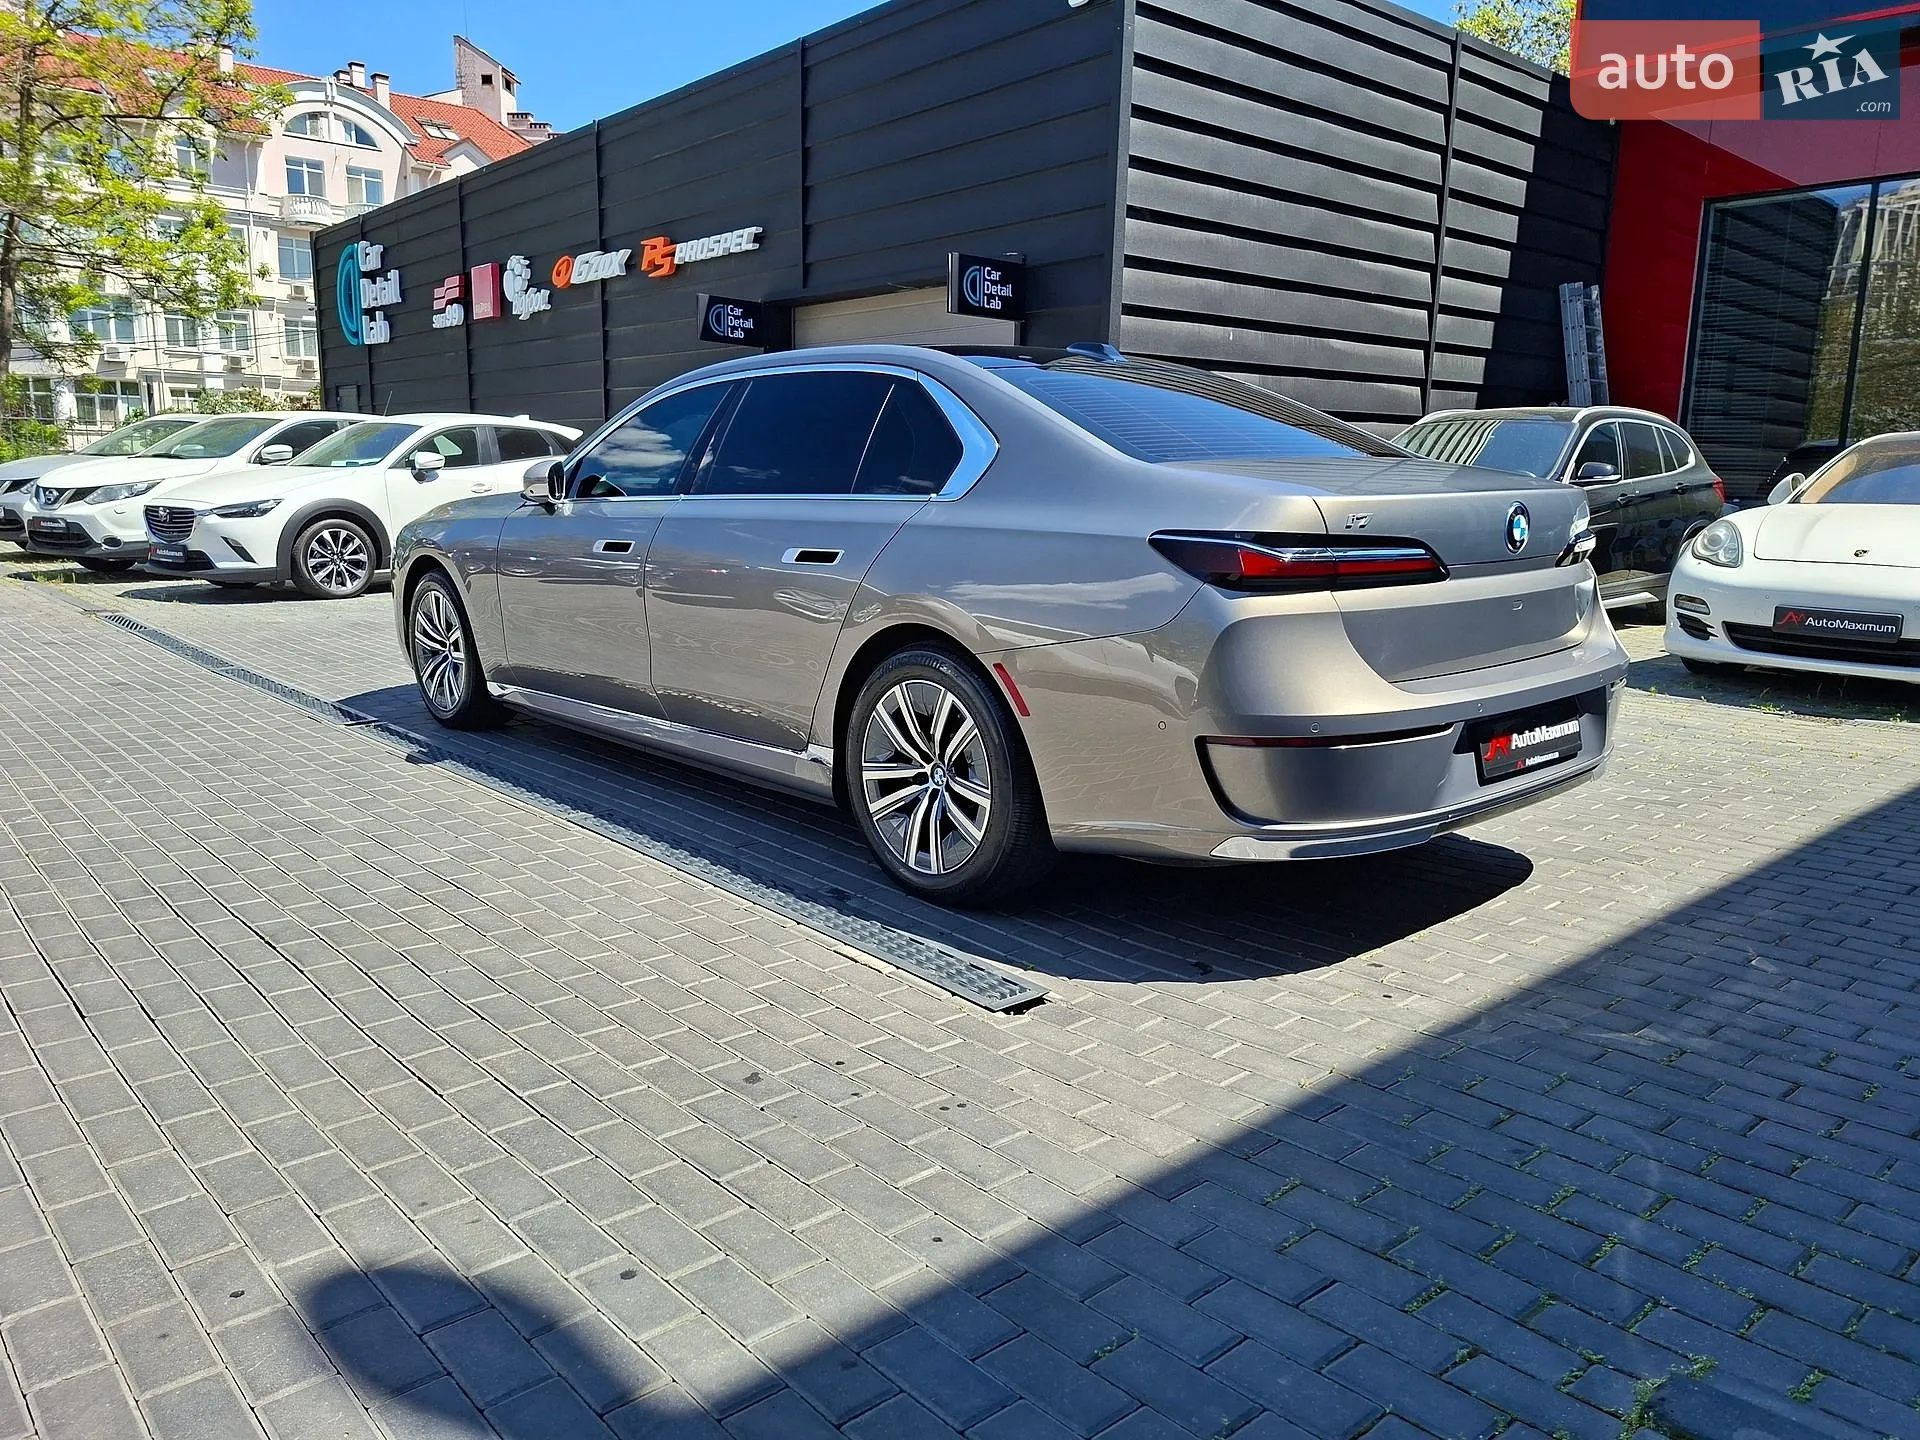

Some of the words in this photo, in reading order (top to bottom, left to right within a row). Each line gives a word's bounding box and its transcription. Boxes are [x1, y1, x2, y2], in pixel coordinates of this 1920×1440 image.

[358, 241, 383, 271] Car
[984, 266, 1002, 280] Car
[360, 270, 402, 309] Detail
[984, 281, 1013, 297] Detail
[727, 304, 743, 317] Car
[984, 296, 1002, 310] Lab
[362, 311, 390, 345] Lab
[728, 316, 754, 329] Detail
[728, 327, 745, 339] Lab
[1805, 616, 1897, 634] AutoMaximum
[1511, 720, 1580, 750] AutoMaximum
